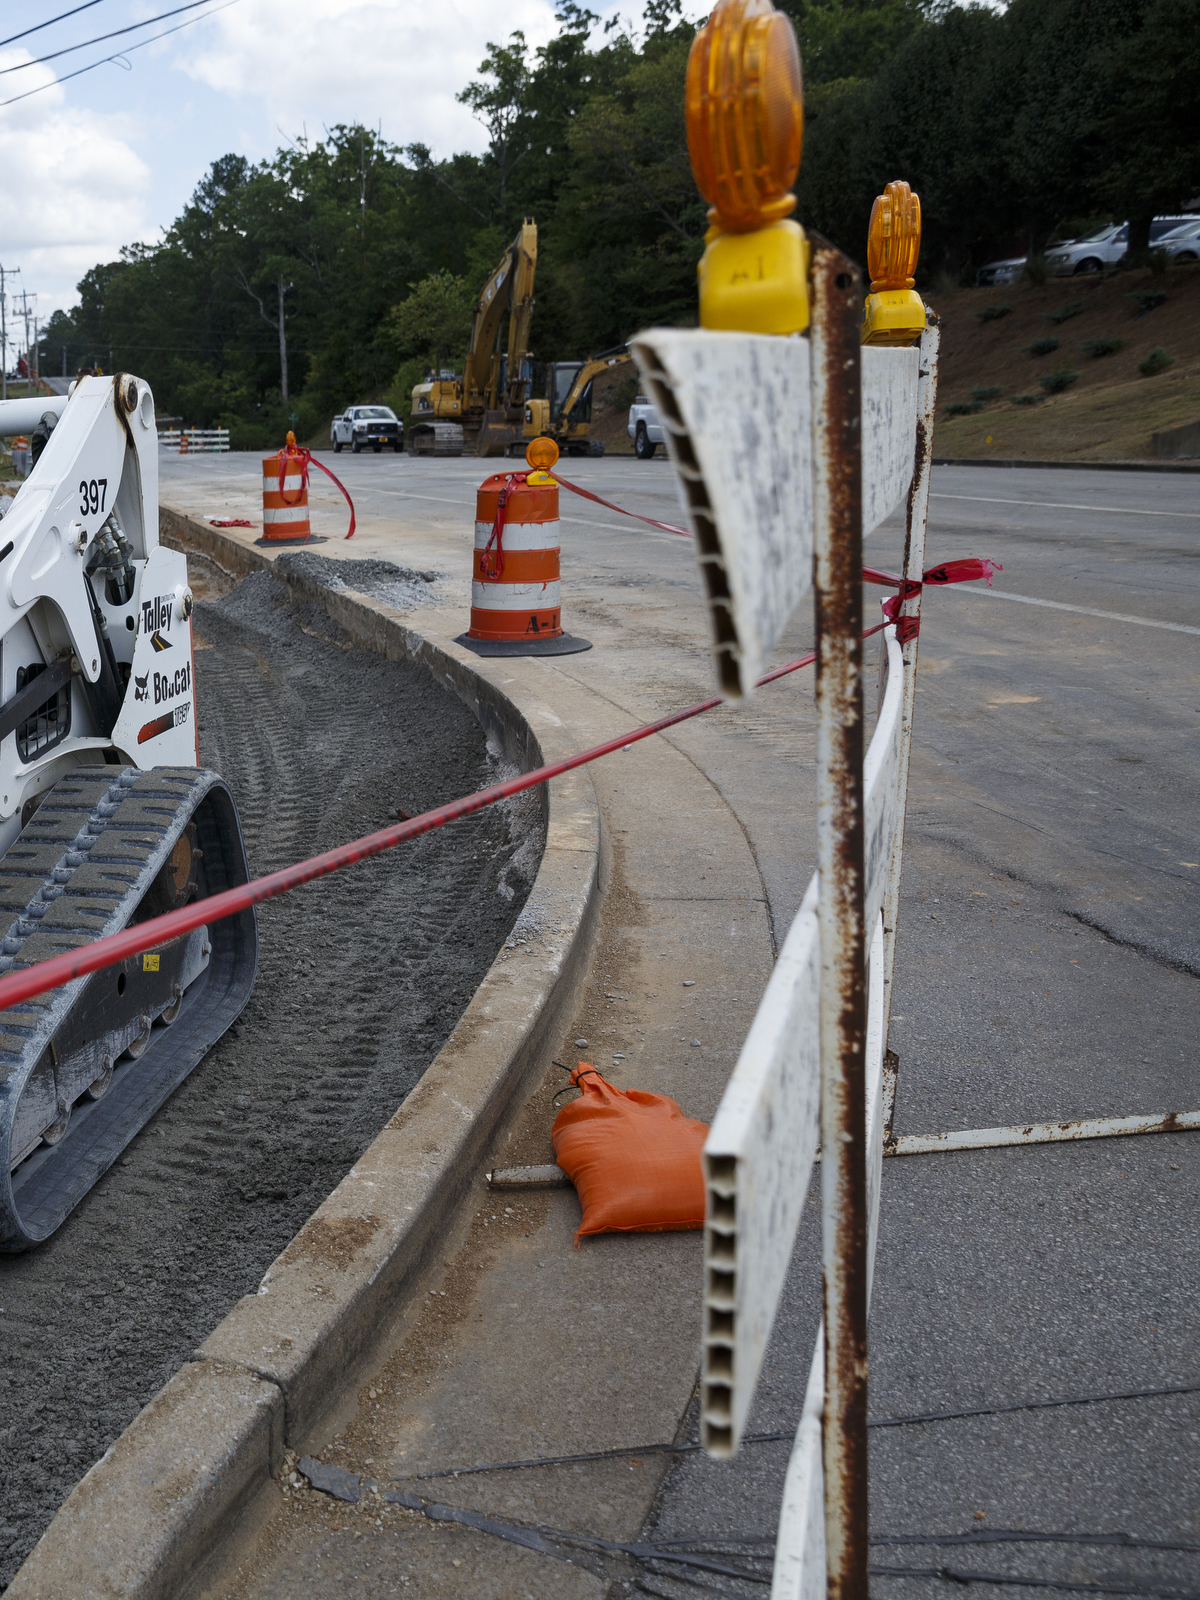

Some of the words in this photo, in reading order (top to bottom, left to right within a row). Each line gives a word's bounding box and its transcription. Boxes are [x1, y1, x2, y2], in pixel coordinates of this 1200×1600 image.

[79, 478, 108, 517] 397
[497, 487, 507, 509] NTER
[142, 595, 173, 634] Talley
